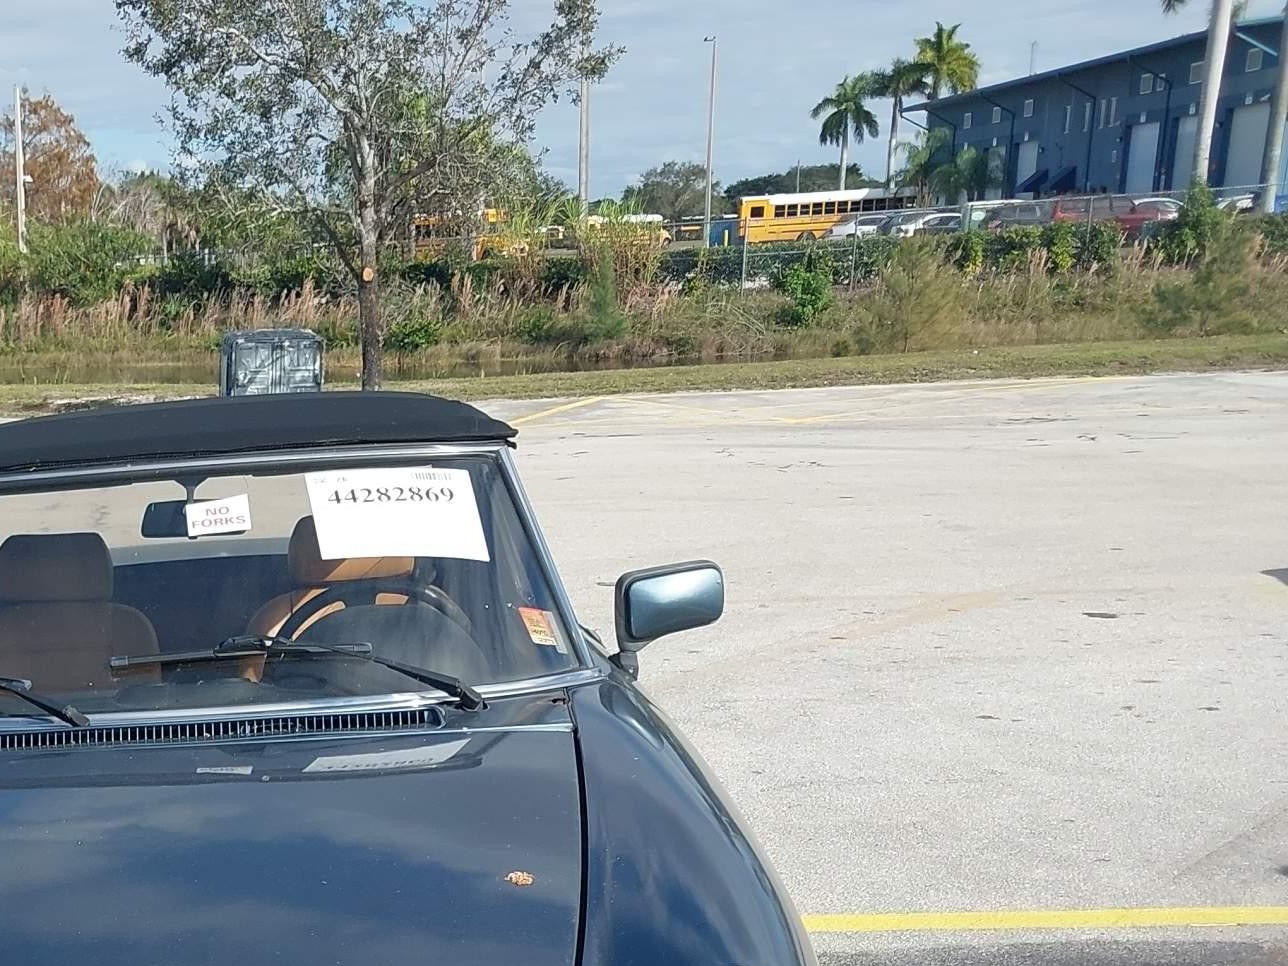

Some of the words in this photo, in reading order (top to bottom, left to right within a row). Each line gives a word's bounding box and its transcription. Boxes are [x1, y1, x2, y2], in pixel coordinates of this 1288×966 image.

[328, 486, 454, 504] 44282869
[205, 506, 230, 516] NO
[192, 515, 246, 528] FORKS
